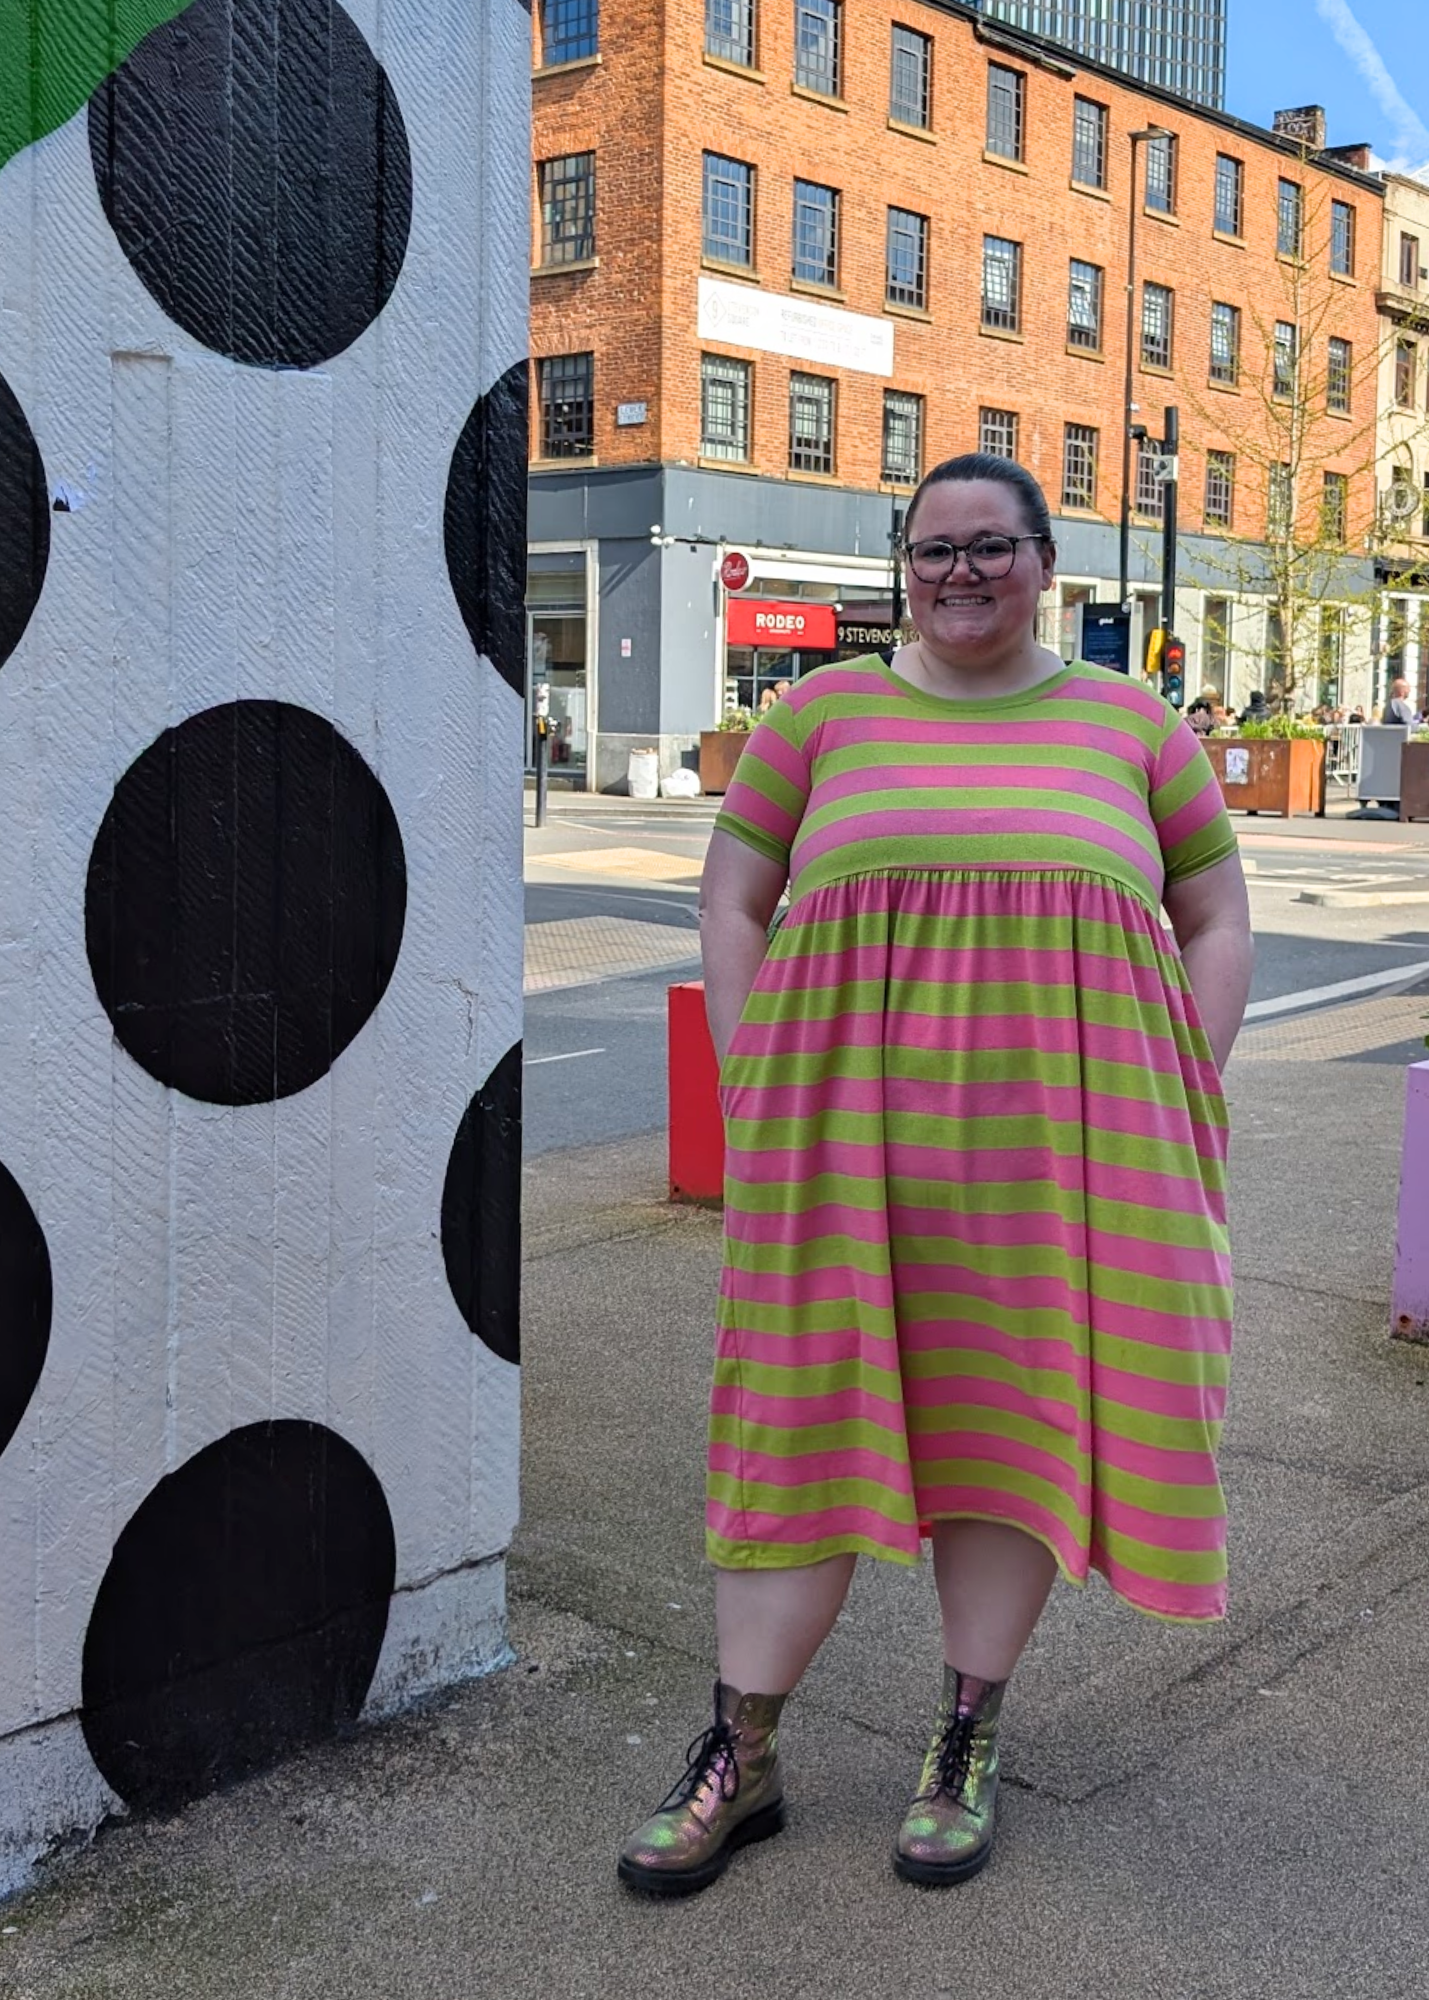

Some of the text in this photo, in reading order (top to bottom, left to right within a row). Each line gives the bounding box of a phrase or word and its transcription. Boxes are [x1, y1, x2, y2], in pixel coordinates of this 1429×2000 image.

[755, 613, 805, 630] RODEO
[837, 626, 845, 642] 9
[846, 626, 907, 645] STEVENSN
